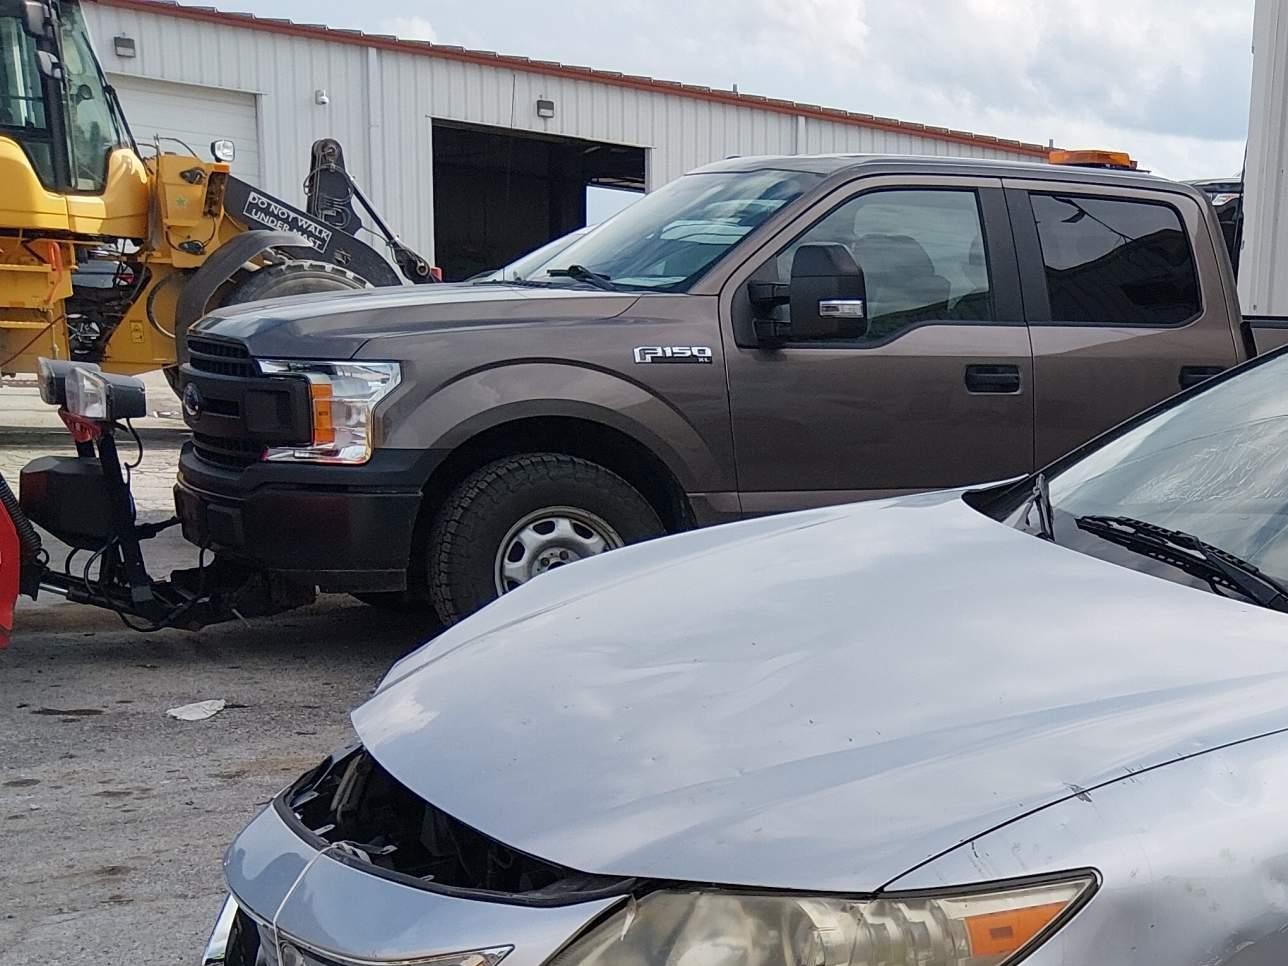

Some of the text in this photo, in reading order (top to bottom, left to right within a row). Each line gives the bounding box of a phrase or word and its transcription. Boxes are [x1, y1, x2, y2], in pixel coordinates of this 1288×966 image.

[249, 195, 329, 240] DO NOT WALK
[251, 208, 290, 231] UNDER
